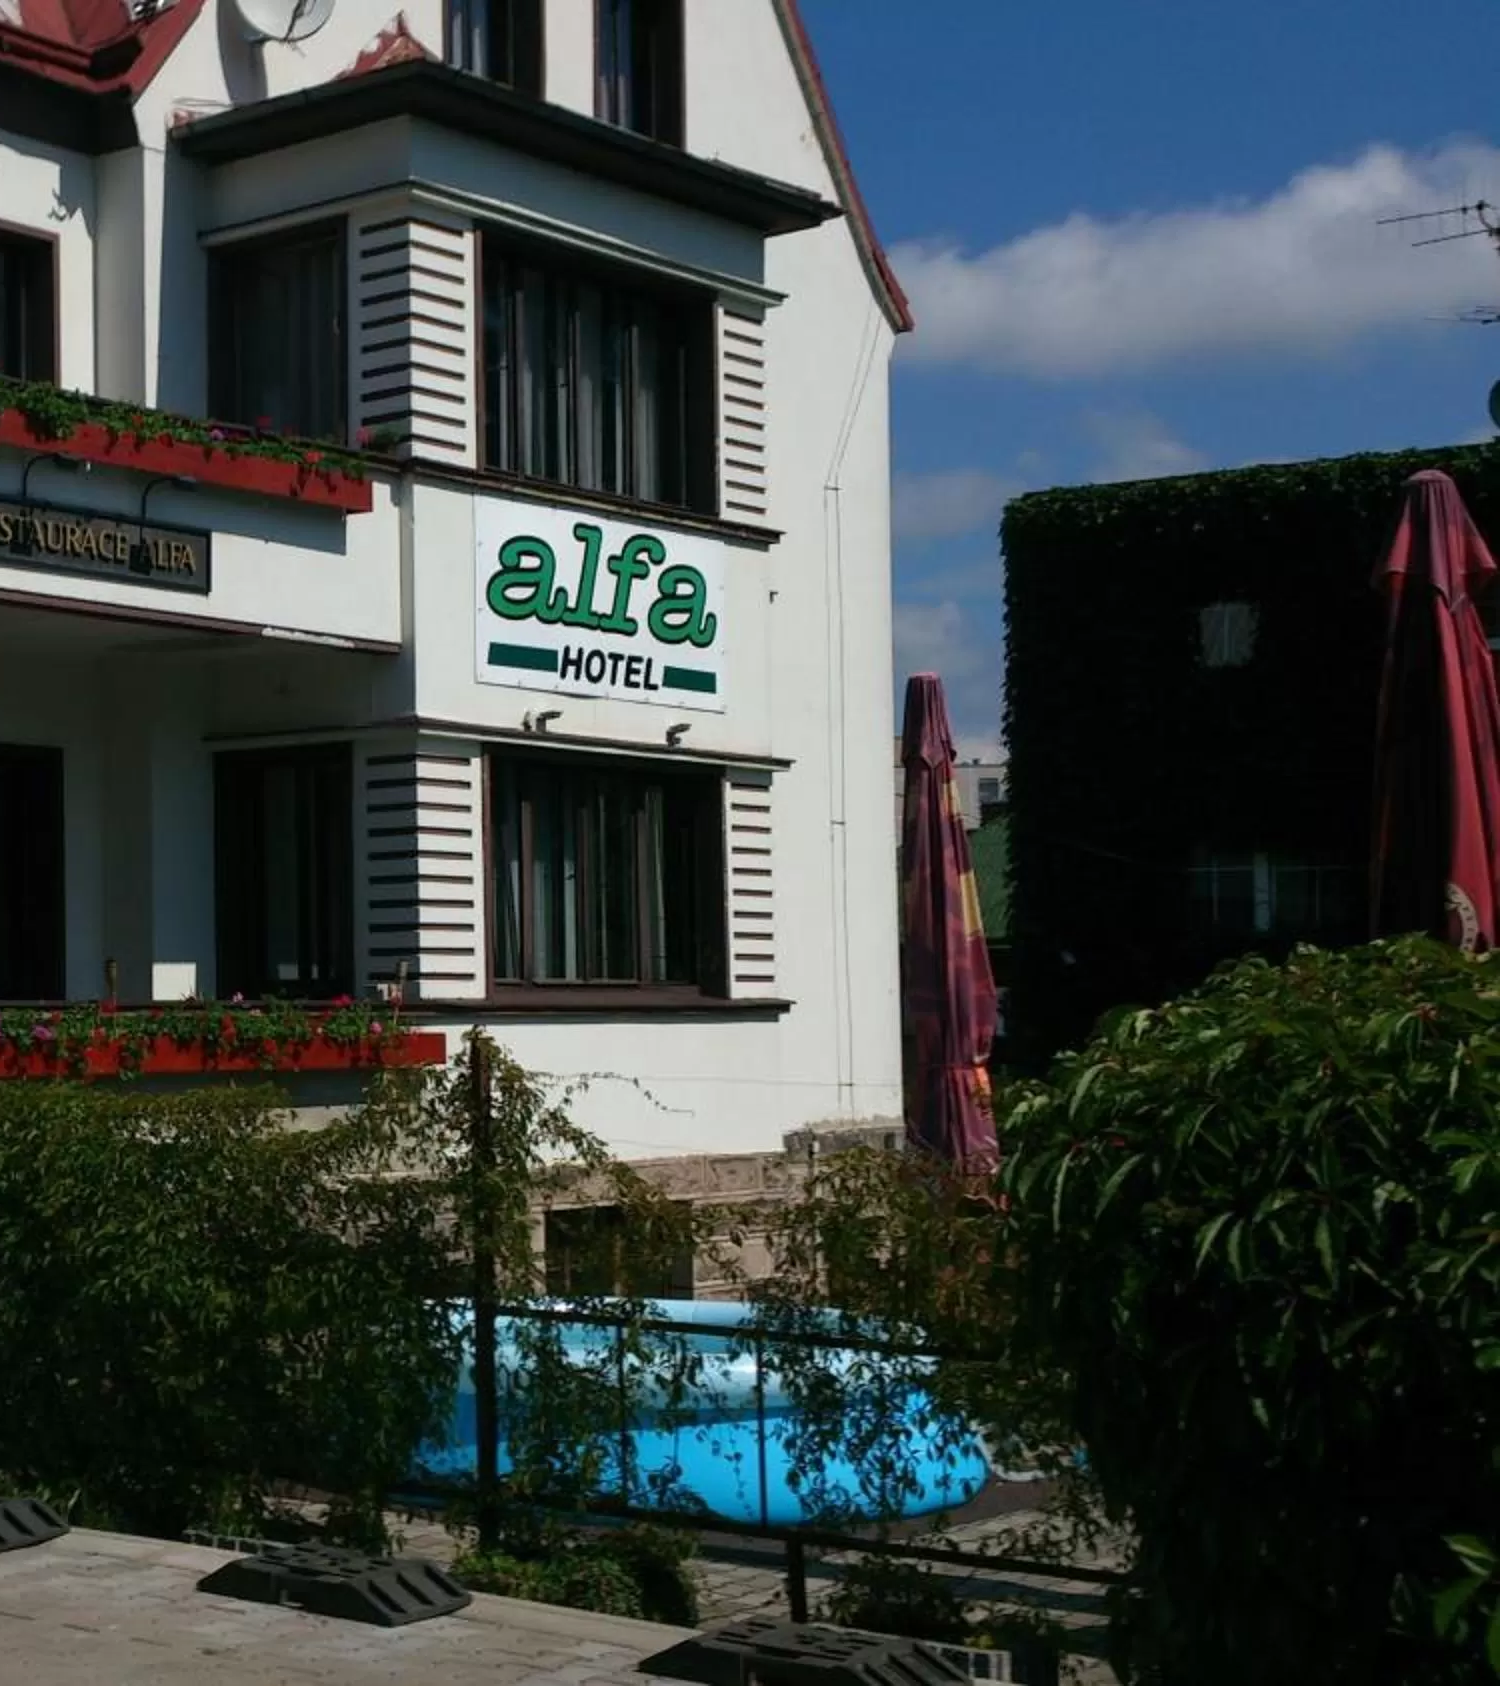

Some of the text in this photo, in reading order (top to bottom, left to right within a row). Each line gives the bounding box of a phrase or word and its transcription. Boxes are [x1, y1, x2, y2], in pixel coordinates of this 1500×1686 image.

[137, 535, 196, 574] ALFA
[486, 522, 717, 648] alfa
[560, 645, 659, 690] HOTEL
